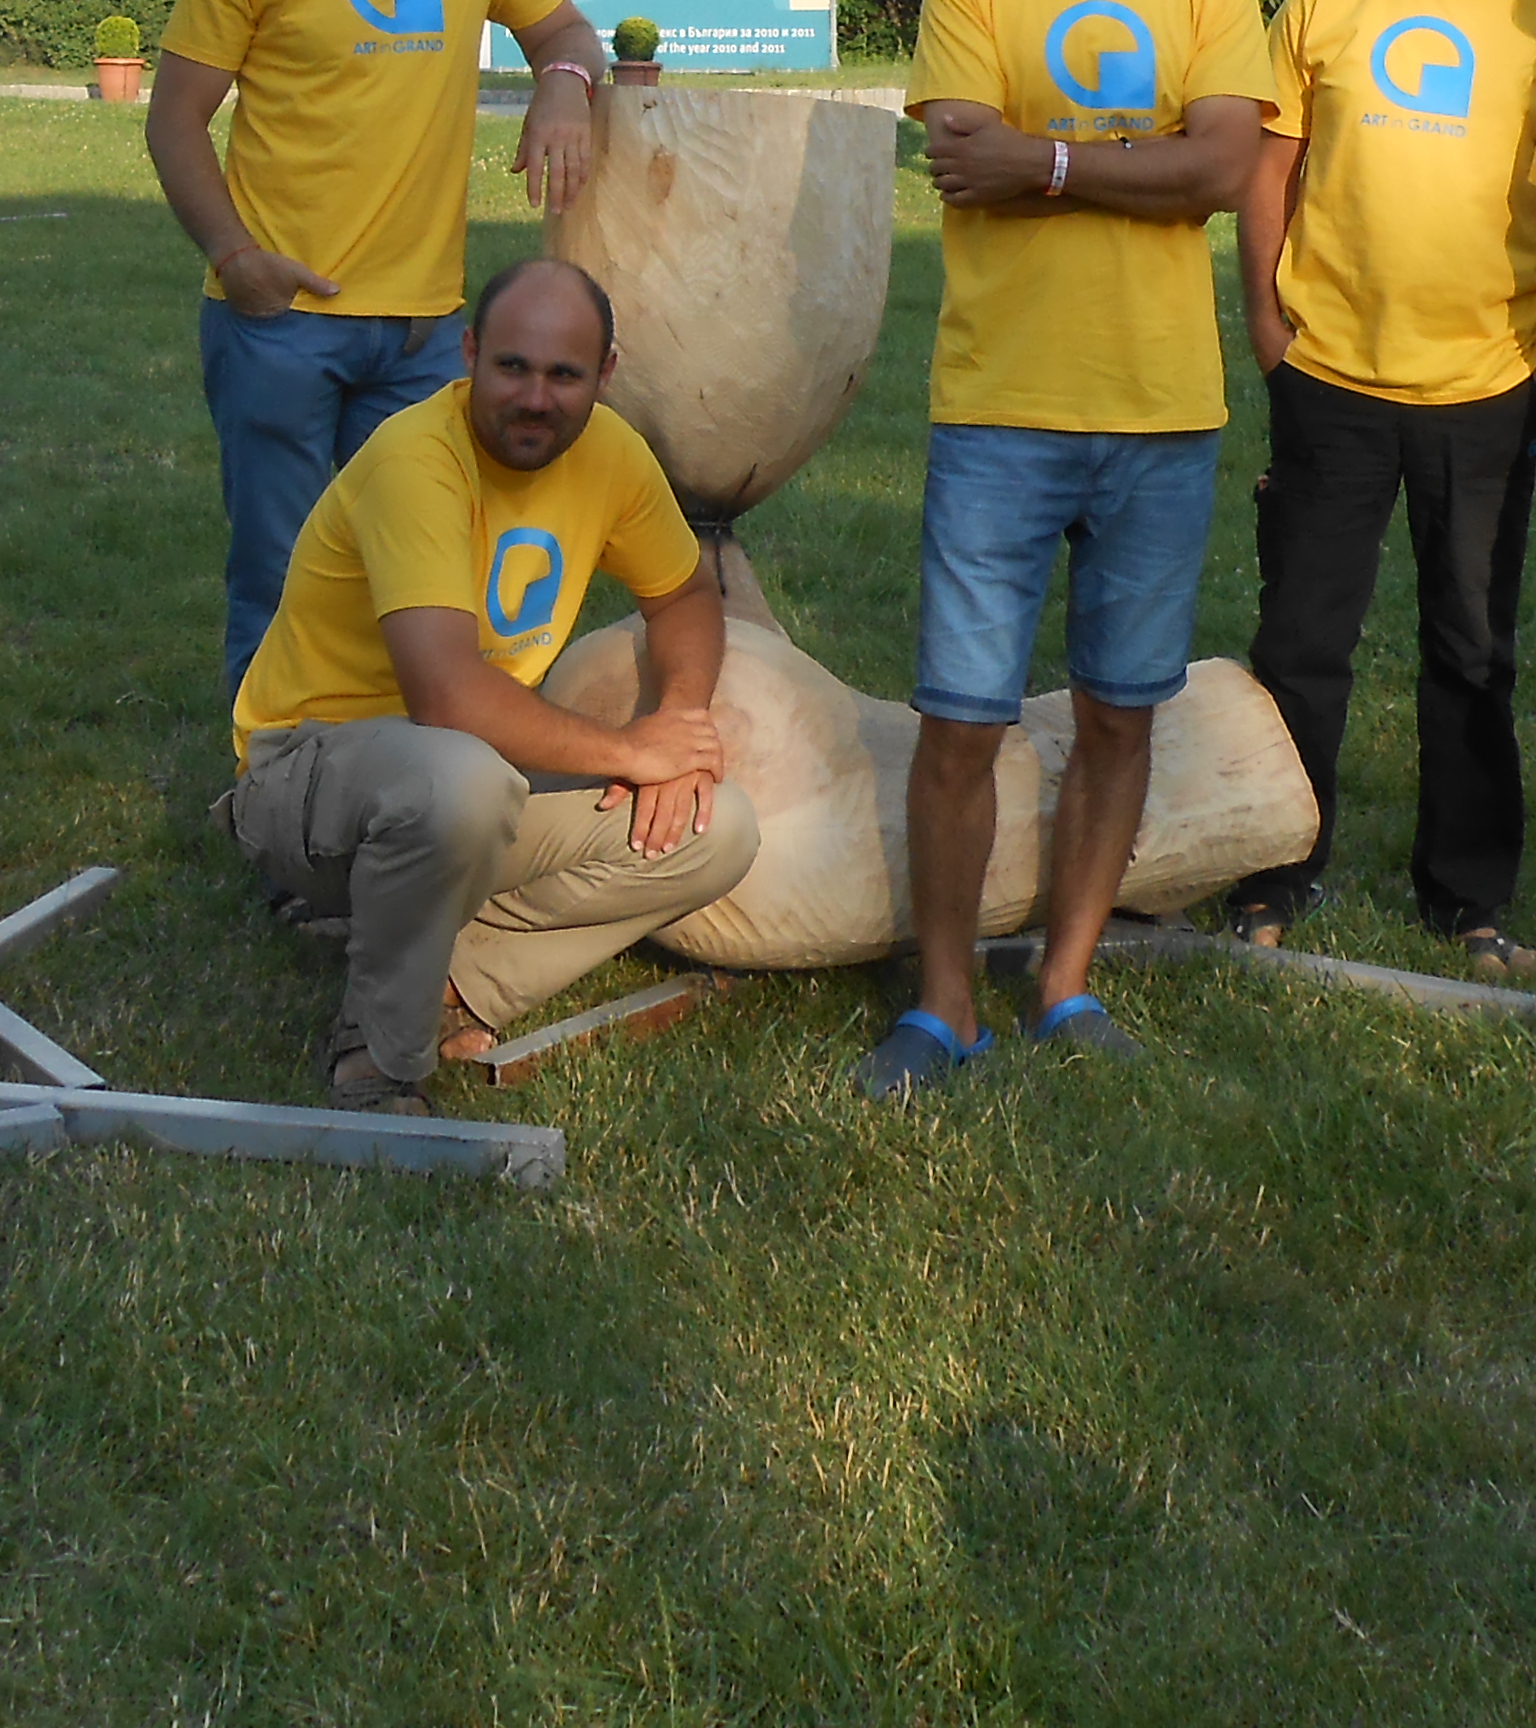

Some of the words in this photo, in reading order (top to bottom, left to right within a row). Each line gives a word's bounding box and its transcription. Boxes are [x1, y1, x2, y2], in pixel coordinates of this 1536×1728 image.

[687, 26, 738, 40] България
[754, 28, 779, 38] 2010
[791, 28, 816, 38] 2011
[354, 41, 378, 55] ART
[393, 39, 445, 54] GRAND
[657, 42, 669, 54] of
[669, 42, 687, 54] the
[688, 43, 711, 56] year
[712, 44, 738, 54] 2010
[739, 42, 760, 54] and
[761, 44, 786, 54] 2011
[1047, 117, 1076, 131] ART
[1093, 116, 1155, 132] GRAND
[1360, 113, 1388, 127] ART
[1408, 118, 1468, 138] GRAND
[509, 632, 552, 657] GRAND
